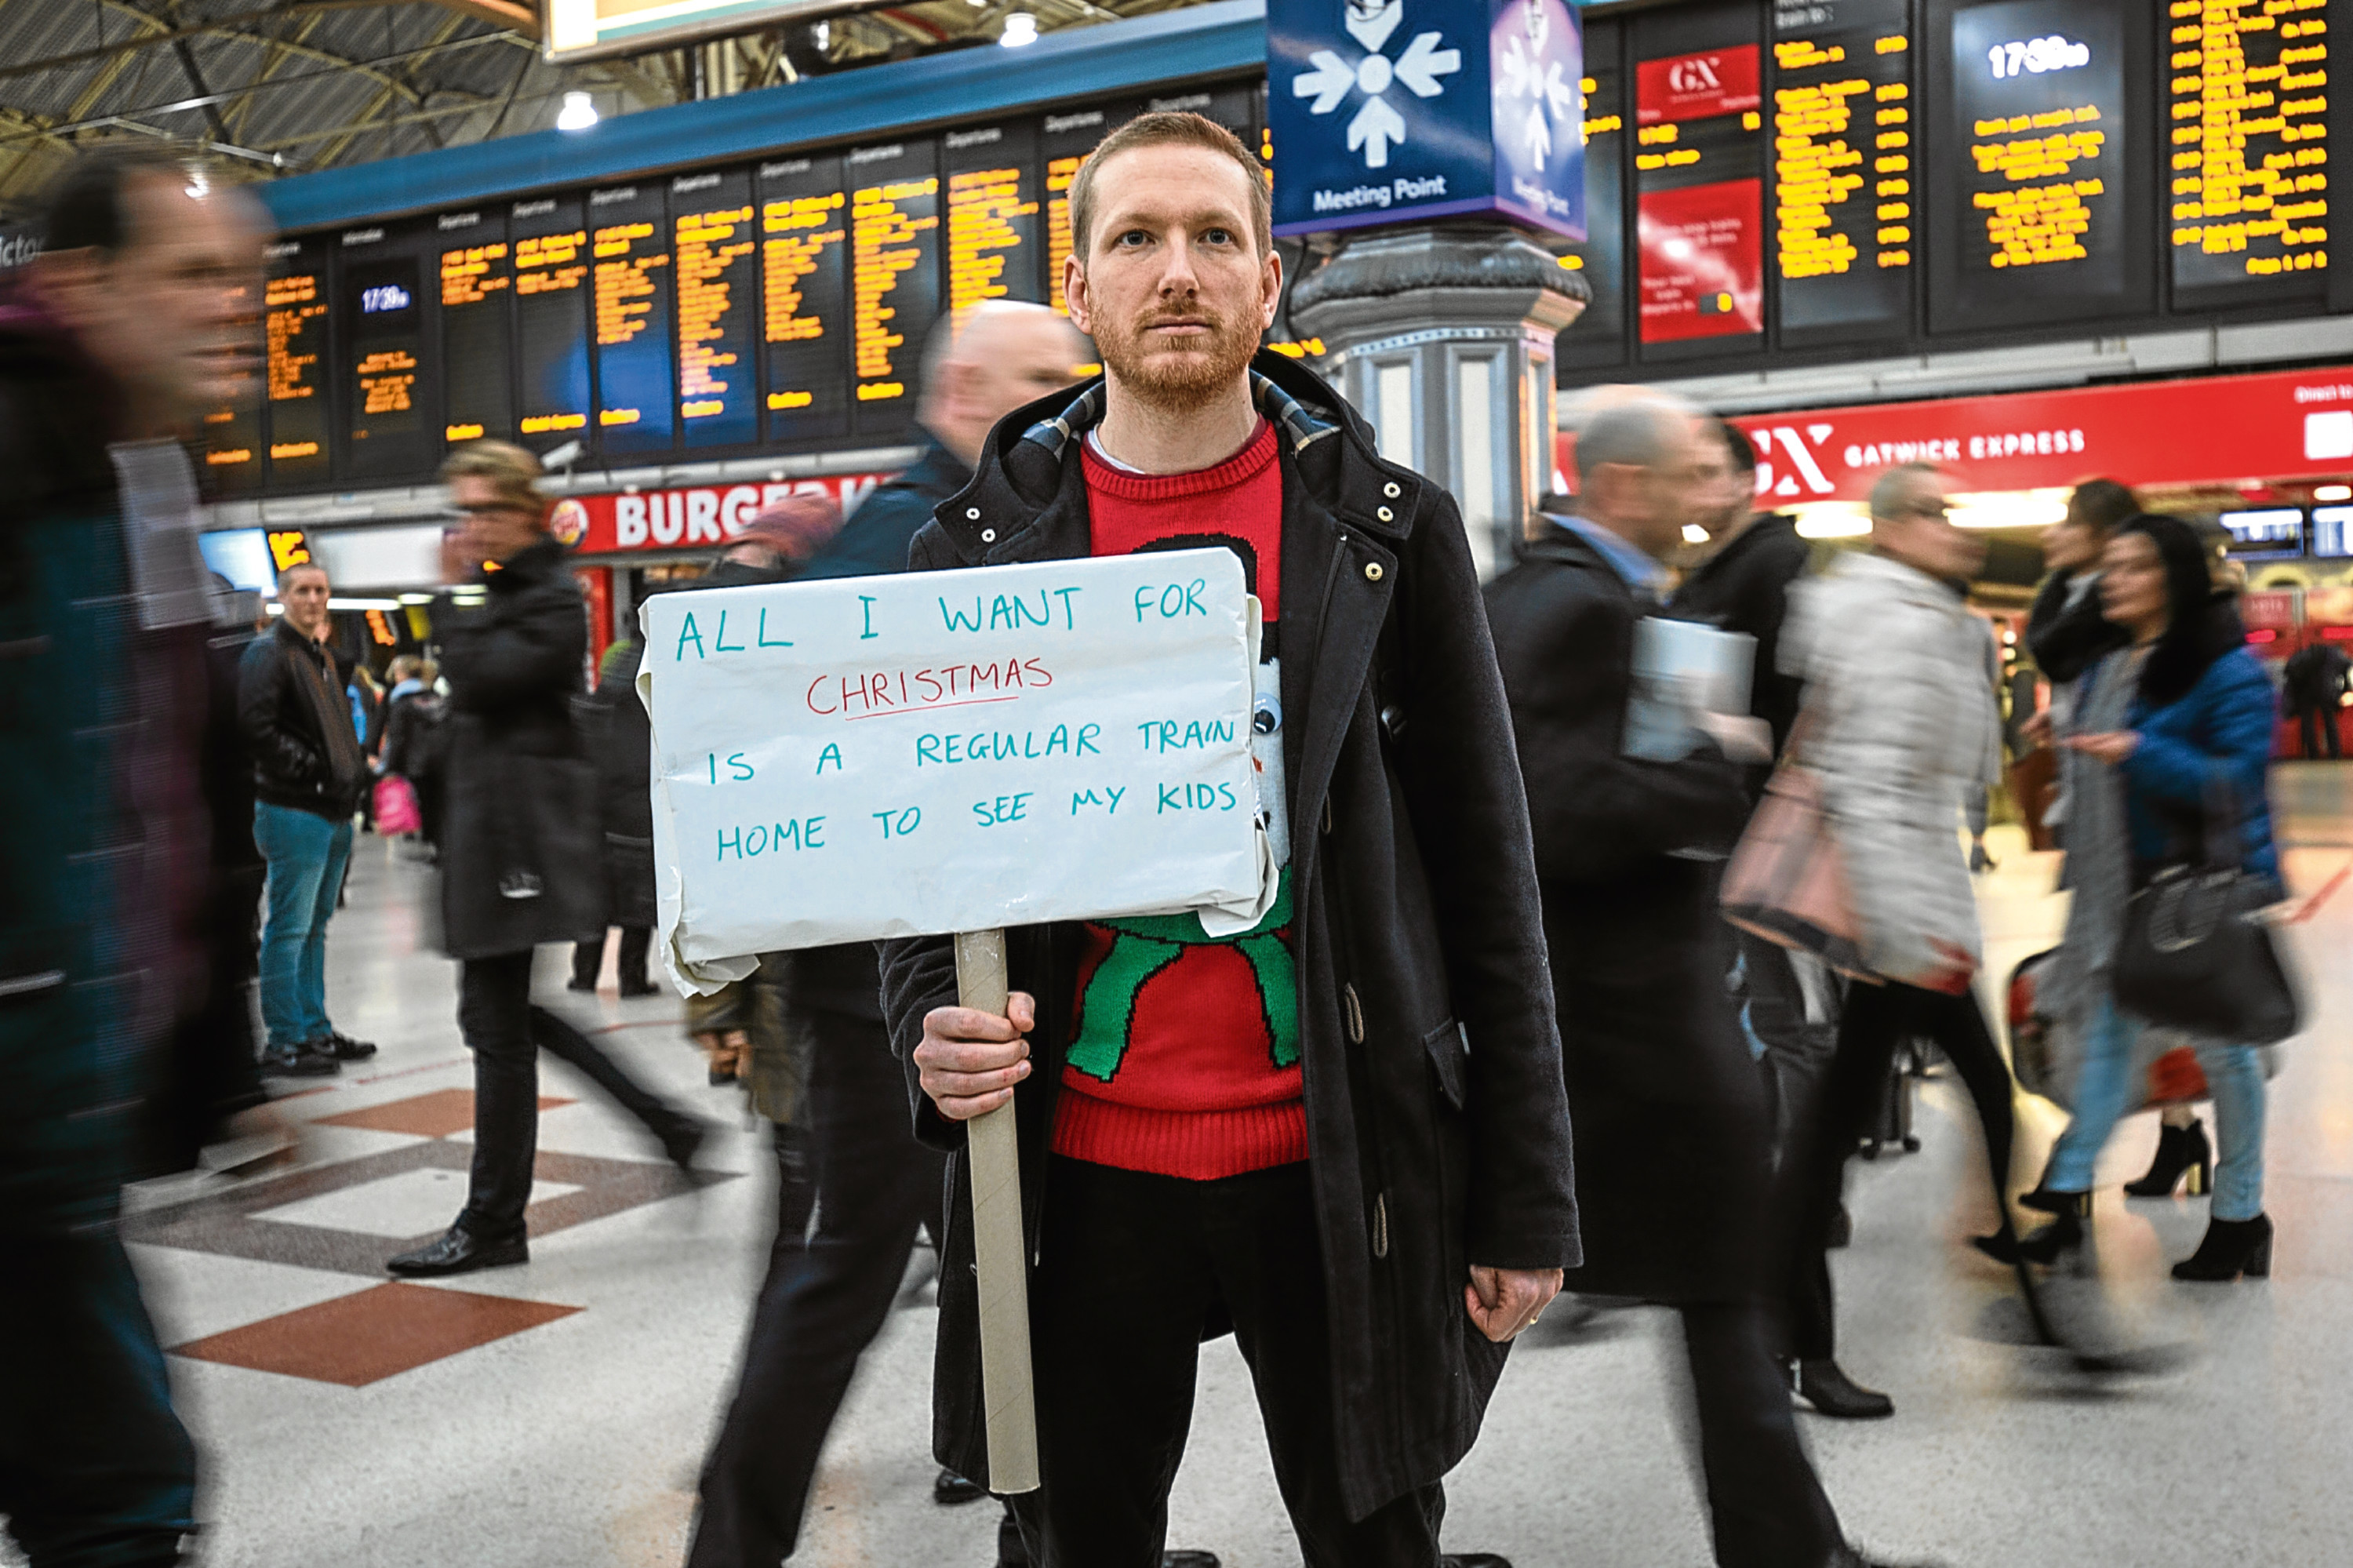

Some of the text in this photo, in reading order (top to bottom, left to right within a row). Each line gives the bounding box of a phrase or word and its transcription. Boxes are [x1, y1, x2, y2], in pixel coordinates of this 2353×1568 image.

[1313, 175, 1447, 212] Meeting Point
[1844, 429, 2085, 467] GATWICK EXPRESS
[677, 578, 1207, 661] ALL I WANT FOR
[806, 657, 1053, 716] CHRISTMAS
[709, 720, 1235, 785] IS A REGULAR TRAIN
[718, 781, 1237, 862] HOME TO SEE MY KIDS
